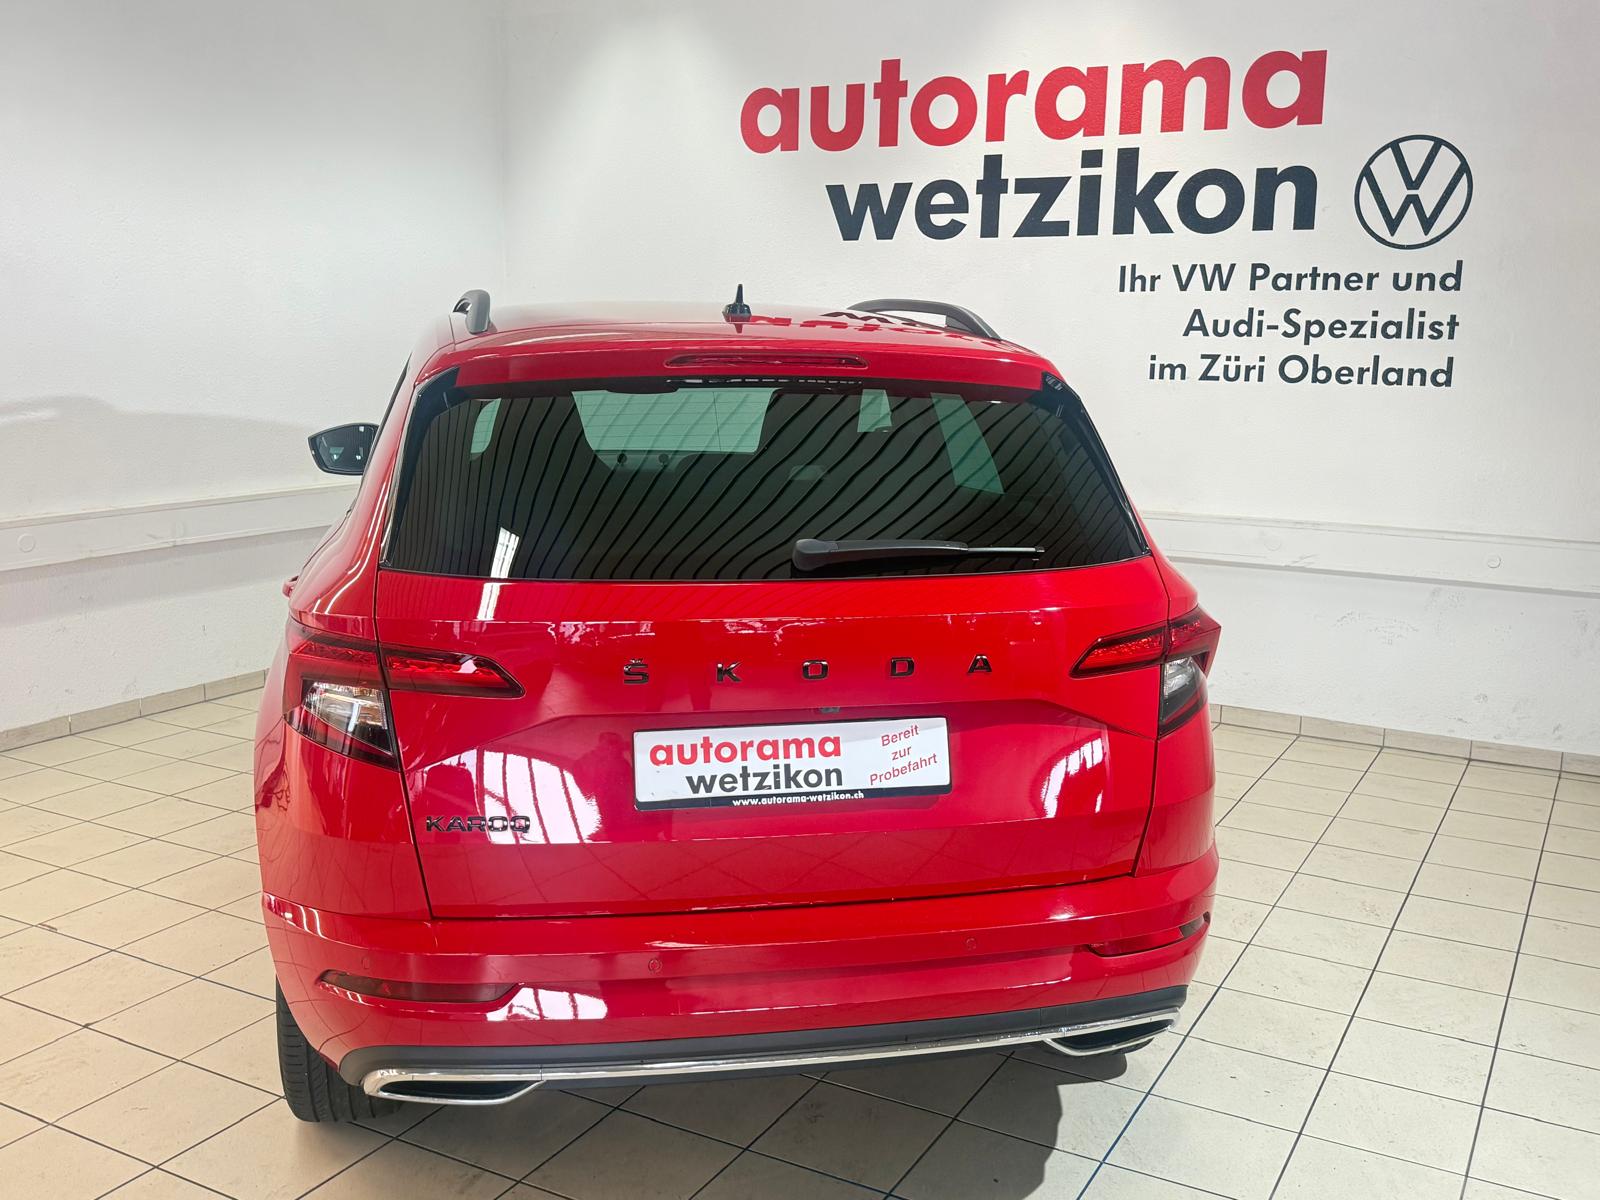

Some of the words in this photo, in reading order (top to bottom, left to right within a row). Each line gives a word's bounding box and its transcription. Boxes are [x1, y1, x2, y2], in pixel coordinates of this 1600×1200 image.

[741, 50, 1327, 153] autorama
[826, 147, 1318, 241] wetzikon
[1119, 265, 1161, 293] Ihr
[1172, 264, 1237, 292] VW
[1250, 263, 1380, 292] Partner
[1392, 260, 1464, 292] und
[1183, 309, 1460, 343] Audi-Spezialist
[1148, 354, 1188, 382] im
[1200, 353, 1266, 384] Züri
[1279, 355, 1454, 387] Oberland
[649, 735, 841, 766] autorama
[881, 724, 920, 748] Bereit
[891, 744, 912, 761] zur
[686, 763, 843, 795] wetzikon
[869, 753, 939, 787] Probefahrt
[732, 791, 865, 807] www.autorama-wetzikon.ch
[426, 815, 531, 833] KAROQ
